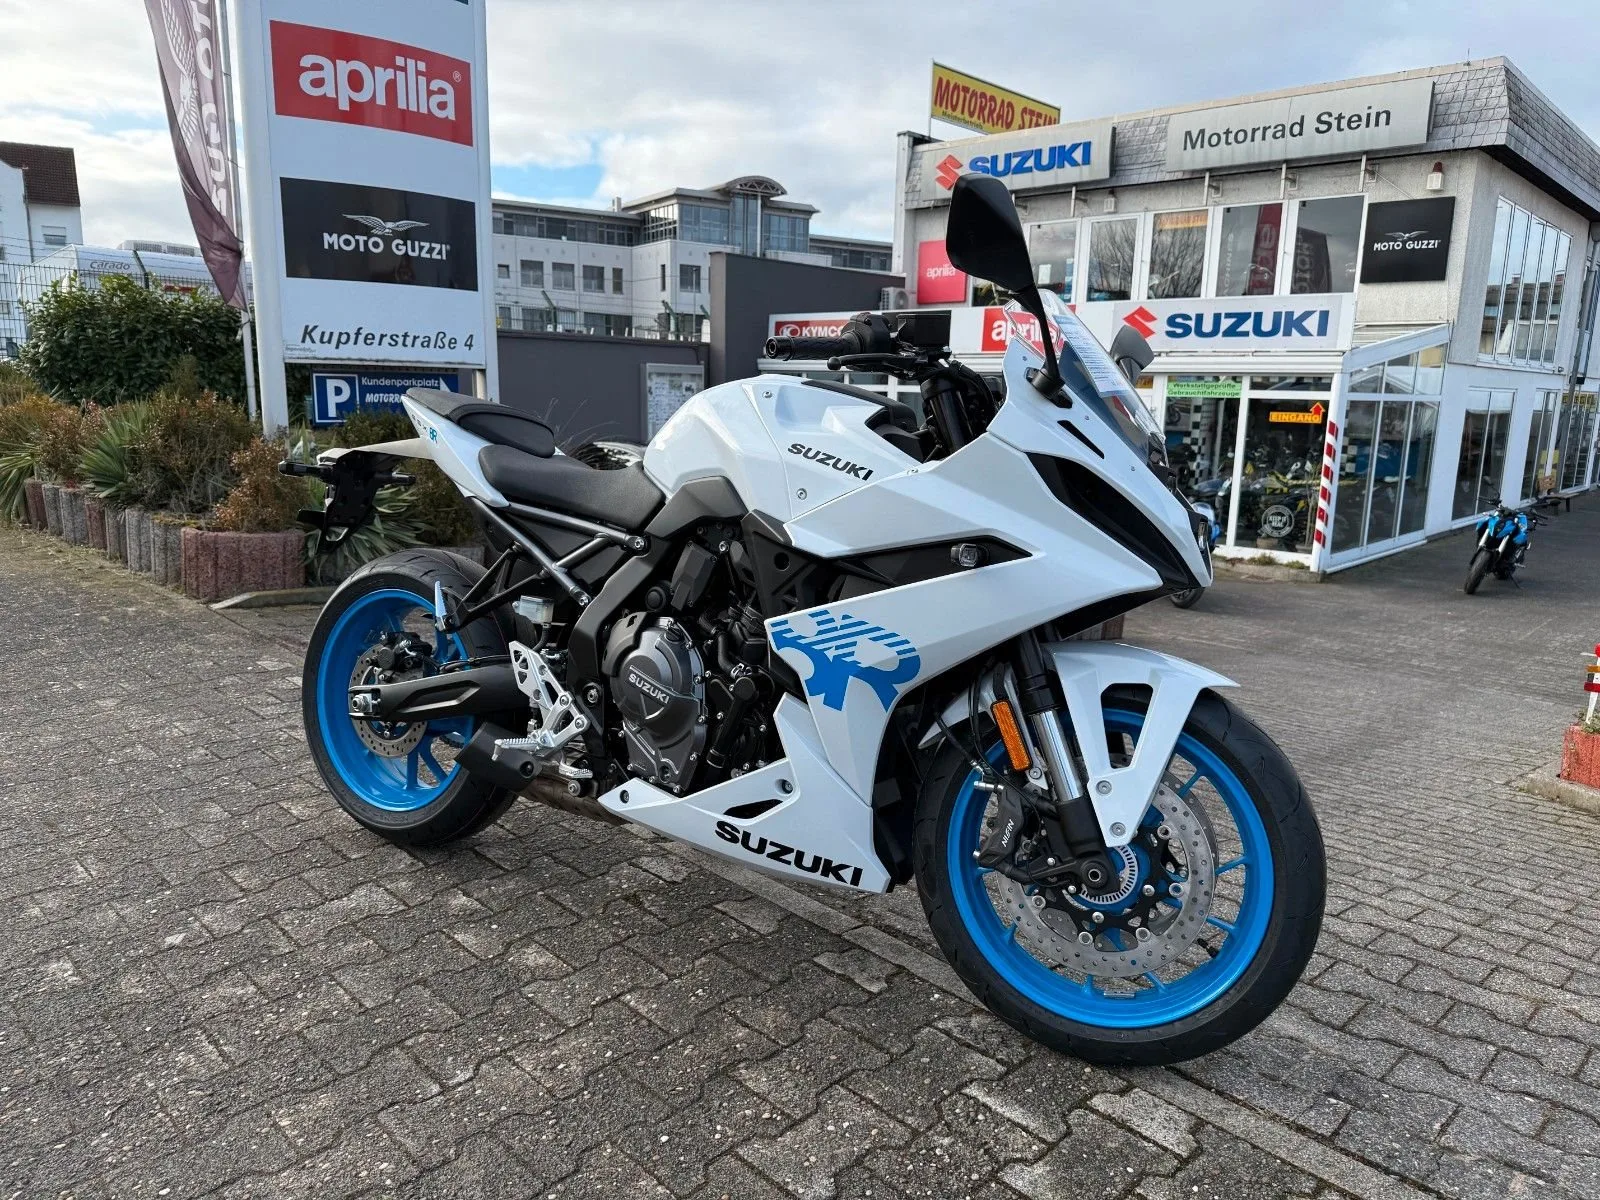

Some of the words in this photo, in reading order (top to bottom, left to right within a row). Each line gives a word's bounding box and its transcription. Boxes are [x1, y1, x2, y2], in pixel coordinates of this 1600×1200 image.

[299, 54, 456, 121] aprilia
[934, 76, 1015, 130] MOTORRAD
[1183, 114, 1305, 151] Motorrad
[1314, 105, 1391, 135] Stein
[968, 141, 1092, 178] SUZUKI
[323, 232, 384, 254] MOTO
[391, 238, 447, 260] GUZZI
[1373, 241, 1402, 251] MOTO
[1405, 239, 1438, 249] GUZZI
[926, 264, 956, 280] aprilia
[301, 324, 458, 350] Kupferstraße
[464, 333, 475, 351] 4
[1165, 310, 1330, 339] SUZUKI
[361, 376, 439, 388] Kundenparkplatz
[326, 378, 350, 418] P
[365, 393, 404, 404] MOTORR
[1271, 413, 1320, 422] EINGANG
[787, 443, 874, 481] SUZUKI
[629, 673, 670, 704] SUZUKI
[714, 820, 864, 887] SUZUKI
